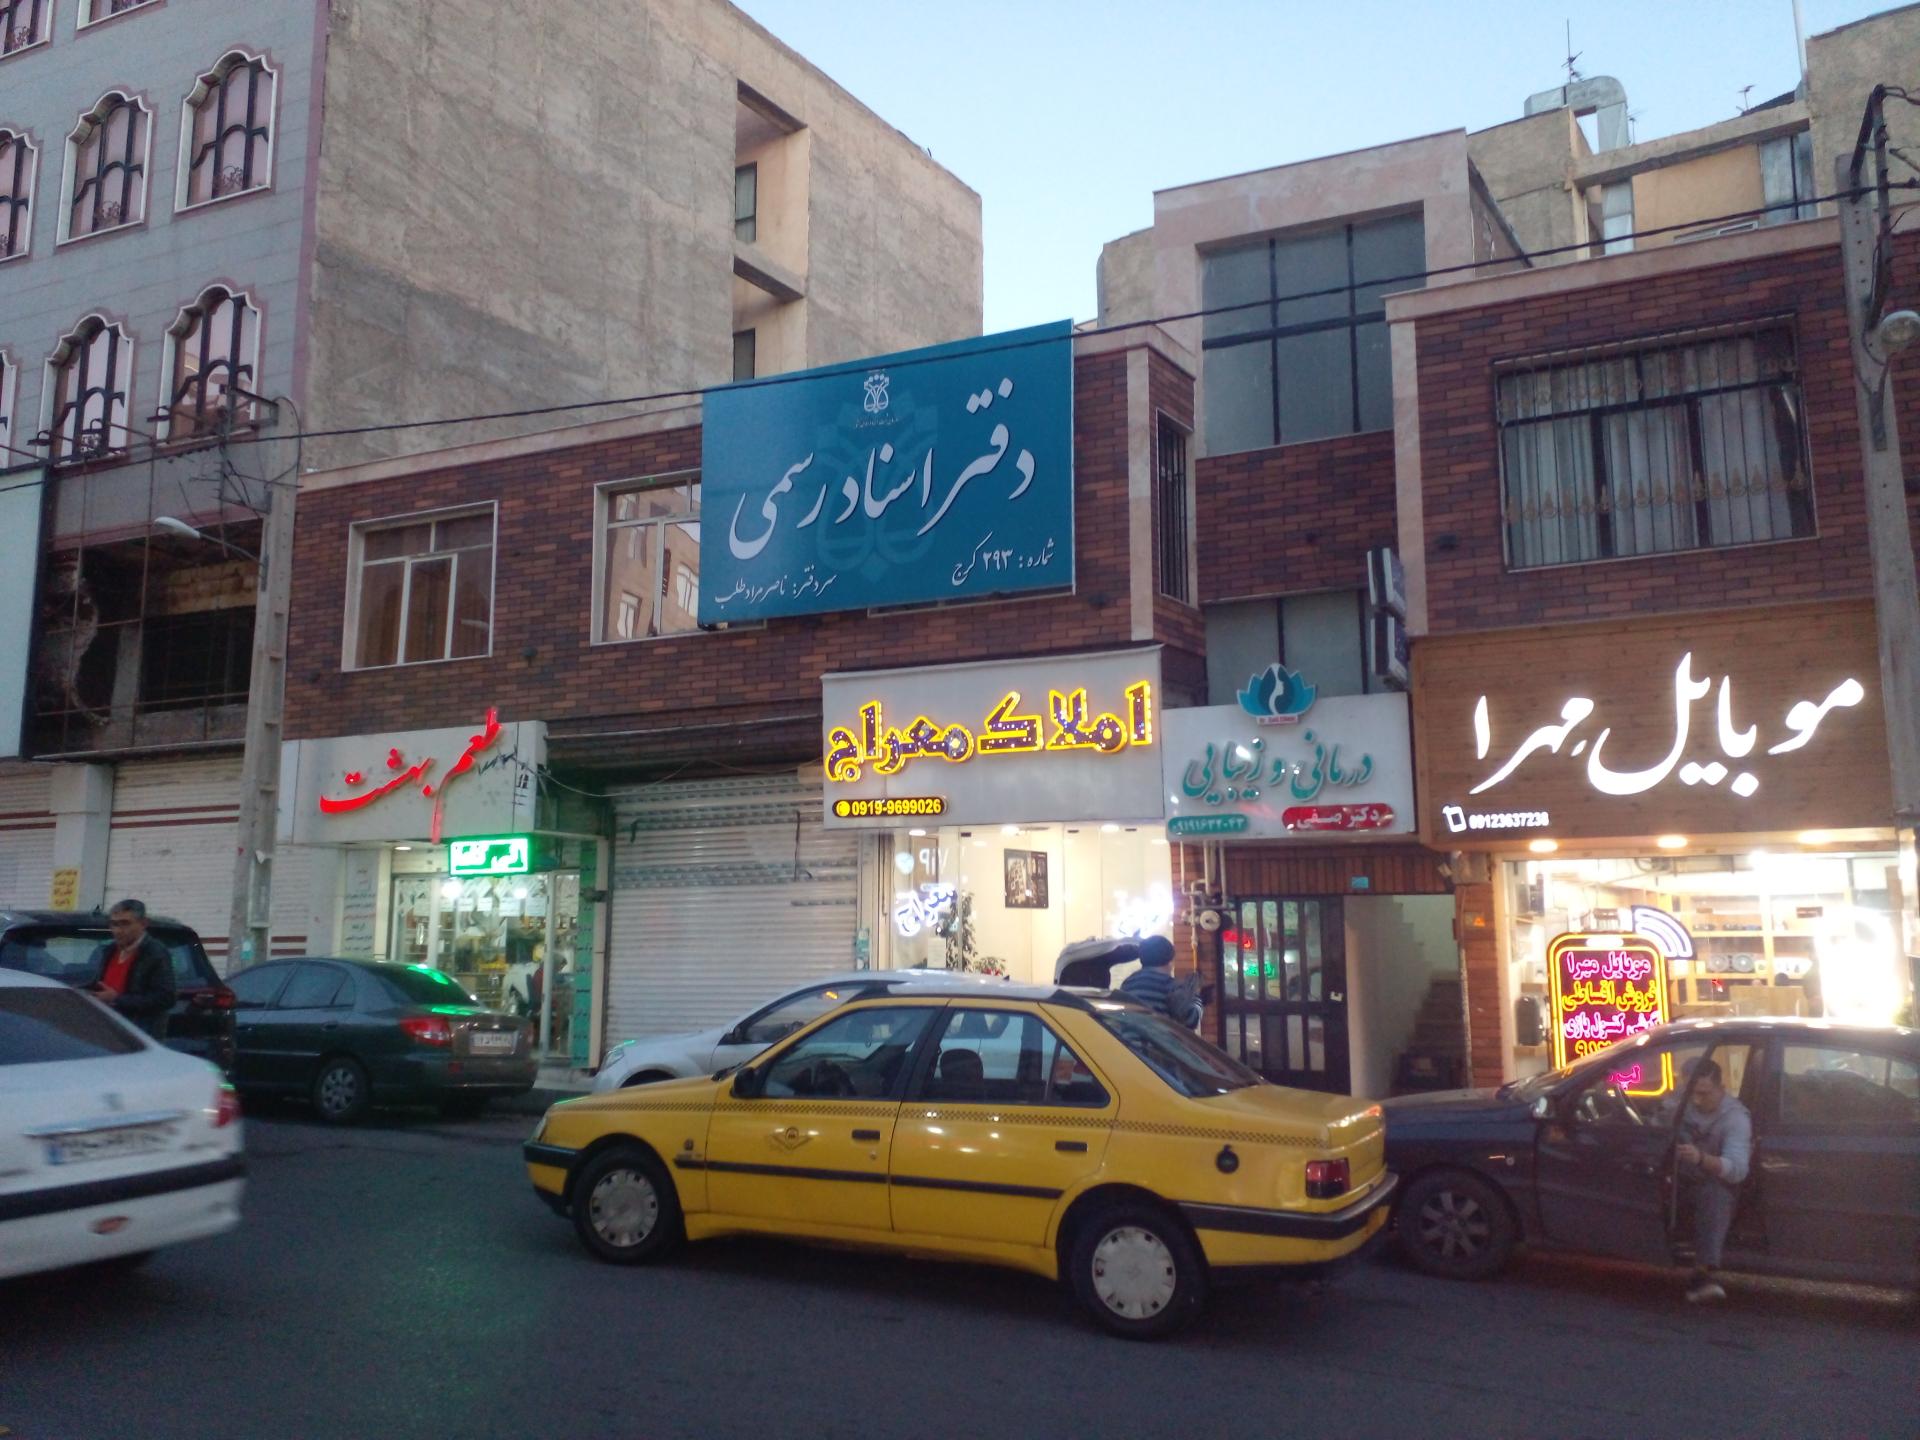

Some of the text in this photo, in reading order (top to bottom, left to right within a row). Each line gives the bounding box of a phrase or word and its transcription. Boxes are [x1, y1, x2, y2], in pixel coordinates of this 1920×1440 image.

[729, 377, 1035, 559] دفتر اسناد رسمی
[952, 531, 993, 586] کرج
[825, 680, 1153, 783] املاک معراج
[1469, 652, 1864, 797] موبایل مهرا
[1182, 730, 1373, 805] درمانی و زیبایی
[851, 799, 942, 816] 0919-9699026
[1346, 806, 1379, 828] دکتر
[1602, 951, 1651, 980] موبایل
[1562, 980, 1658, 1012] فروش اقساطی
